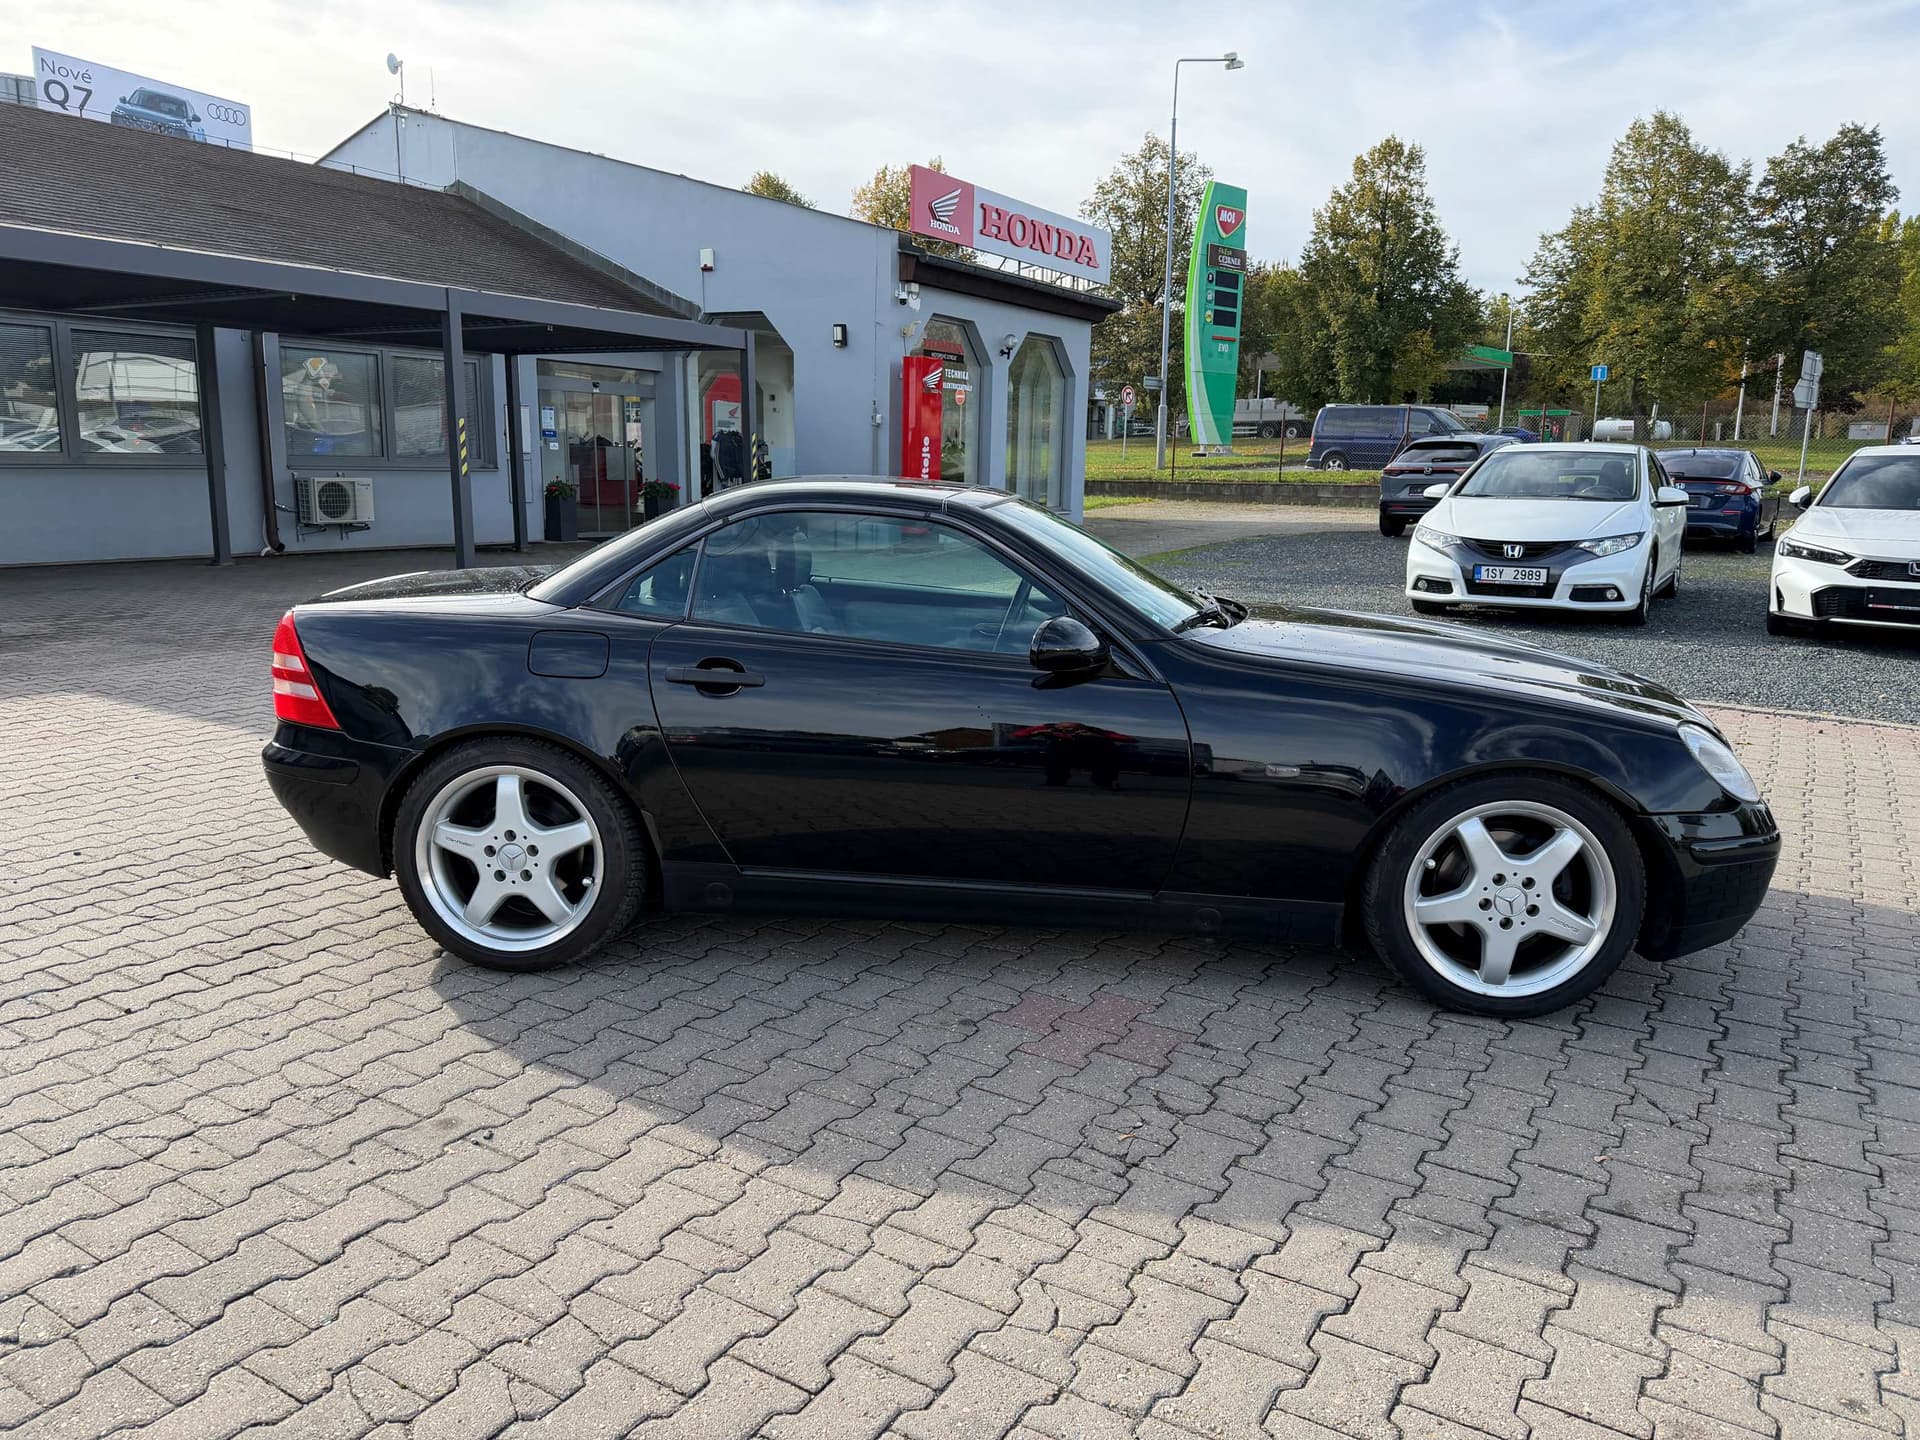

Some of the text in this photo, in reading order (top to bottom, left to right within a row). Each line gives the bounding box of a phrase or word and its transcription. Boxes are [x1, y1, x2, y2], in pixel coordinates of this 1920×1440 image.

[40, 57, 92, 84] Nové
[43, 79, 93, 111] Q7
[1220, 210, 1236, 224] MOL
[930, 219, 961, 236] HONDA
[980, 203, 1099, 268] HONDA
[1218, 343, 1229, 353] EVO
[944, 368, 969, 380] TECHNIKA
[1484, 567, 1542, 581] 1SY 2989
